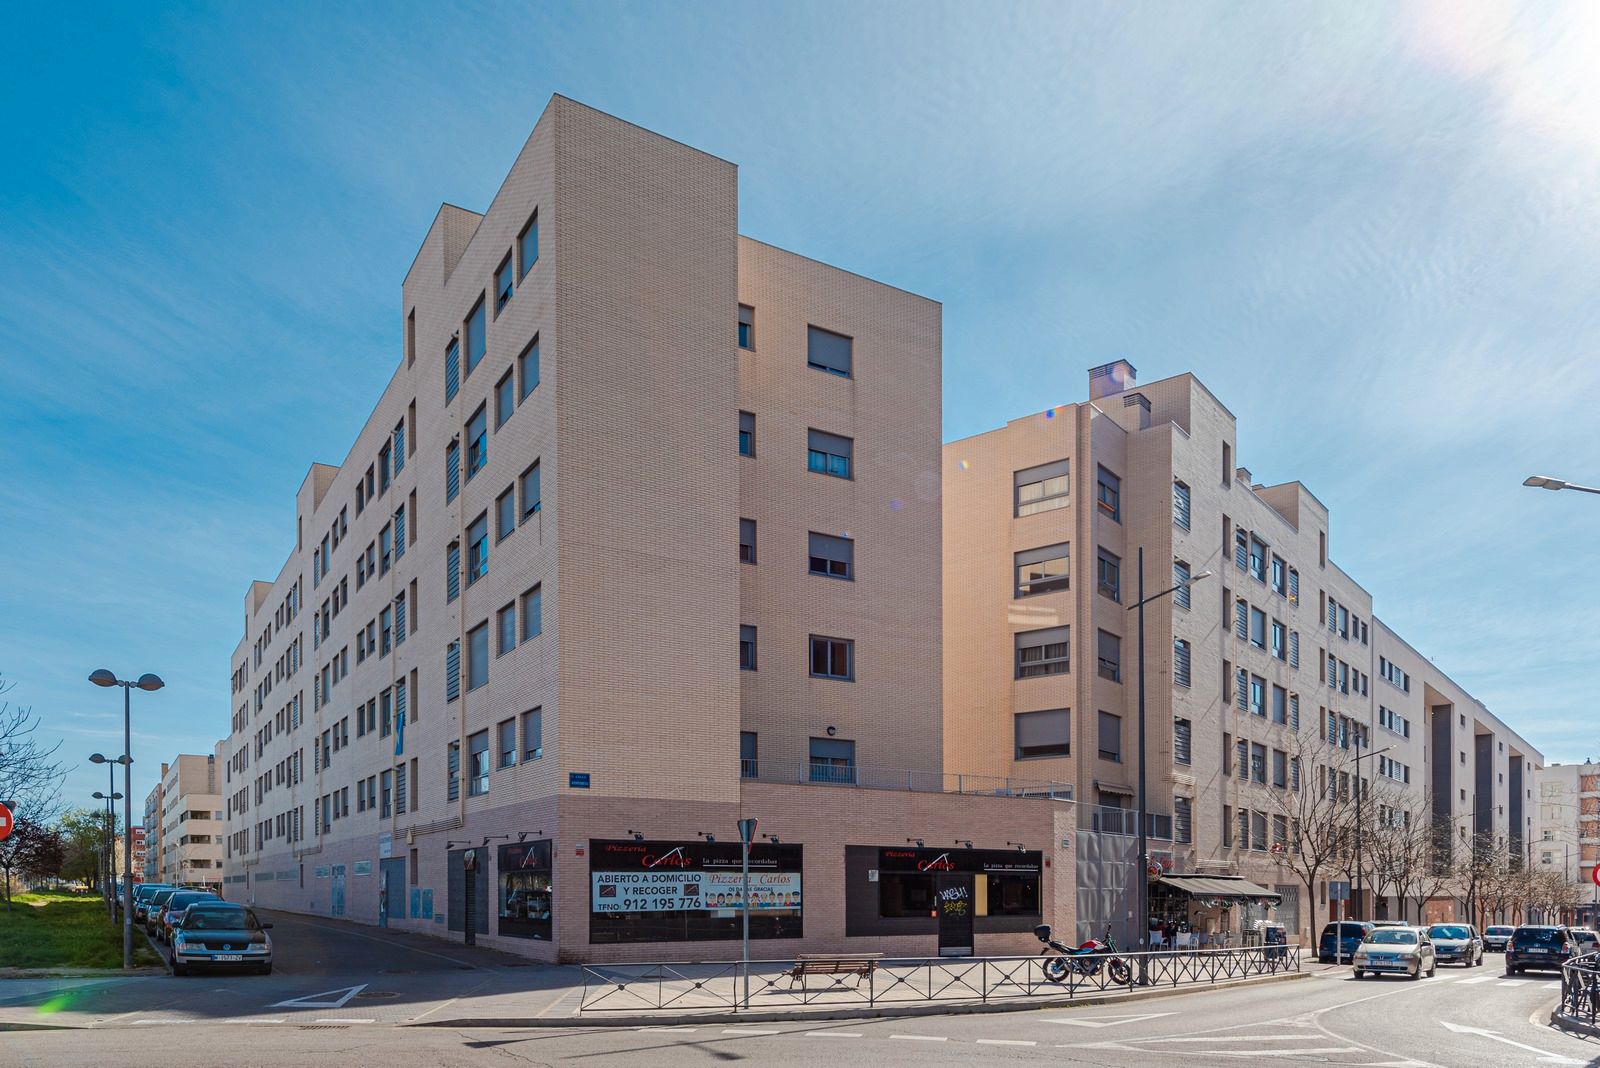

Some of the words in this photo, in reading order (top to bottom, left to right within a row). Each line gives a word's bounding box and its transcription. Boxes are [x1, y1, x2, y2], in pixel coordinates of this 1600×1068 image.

[598, 875, 640, 883] ABIERTO
[642, 875, 649, 883] A
[652, 874, 701, 883] DOMICILIO
[710, 874, 753, 884] Pizzera
[759, 873, 792, 885] Carlos
[623, 887, 630, 895] Y
[632, 886, 678, 895] RECOGER
[623, 898, 648, 910] 912
[652, 898, 675, 909] 195
[679, 897, 701, 908] 776
